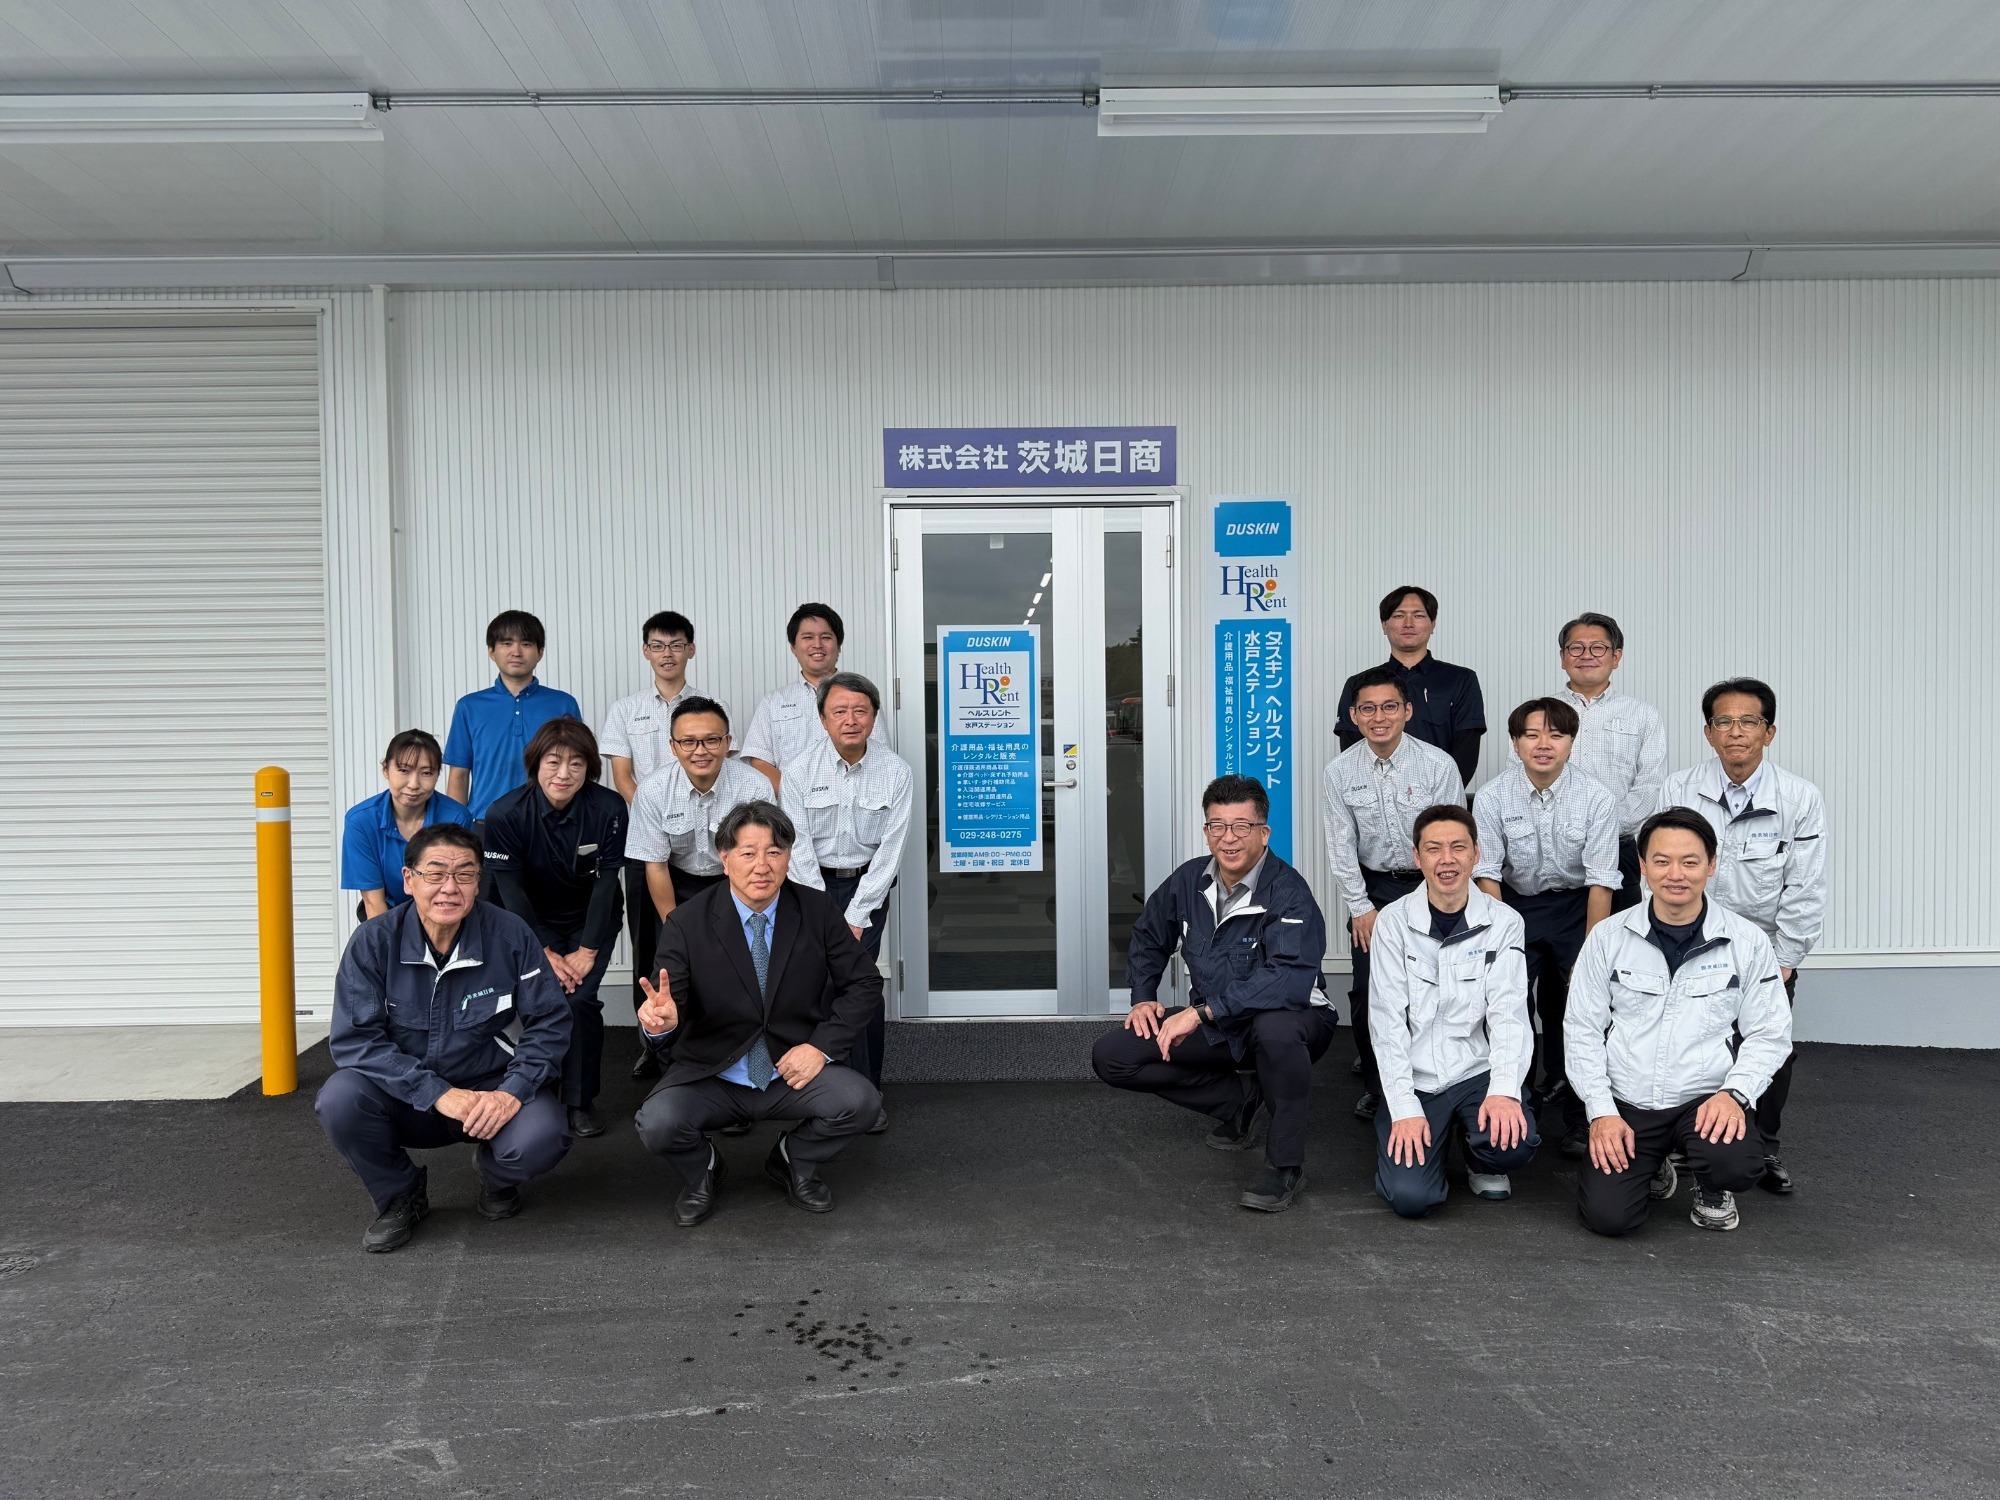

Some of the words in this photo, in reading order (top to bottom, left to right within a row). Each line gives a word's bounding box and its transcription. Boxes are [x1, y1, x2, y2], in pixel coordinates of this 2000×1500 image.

[899, 444, 1008, 470] 株式会社
[1017, 439, 1161, 473] 茨城日商
[1226, 522, 1280, 536] DUSKIN
[1219, 564, 1278, 596] Health
[1243, 582, 1288, 612] Rent
[966, 636, 1011, 648] DUSKIN
[1265, 630, 1283, 689] ダスキン
[959, 662, 1011, 690] Health
[980, 678, 1020, 705] Rent
[1244, 630, 1261, 756] 水戸ステーション
[963, 752, 1016, 760] レンタルと販売
[1265, 694, 1283, 789] ヘルスレント
[960, 831, 1022, 839] 029-248-0275
